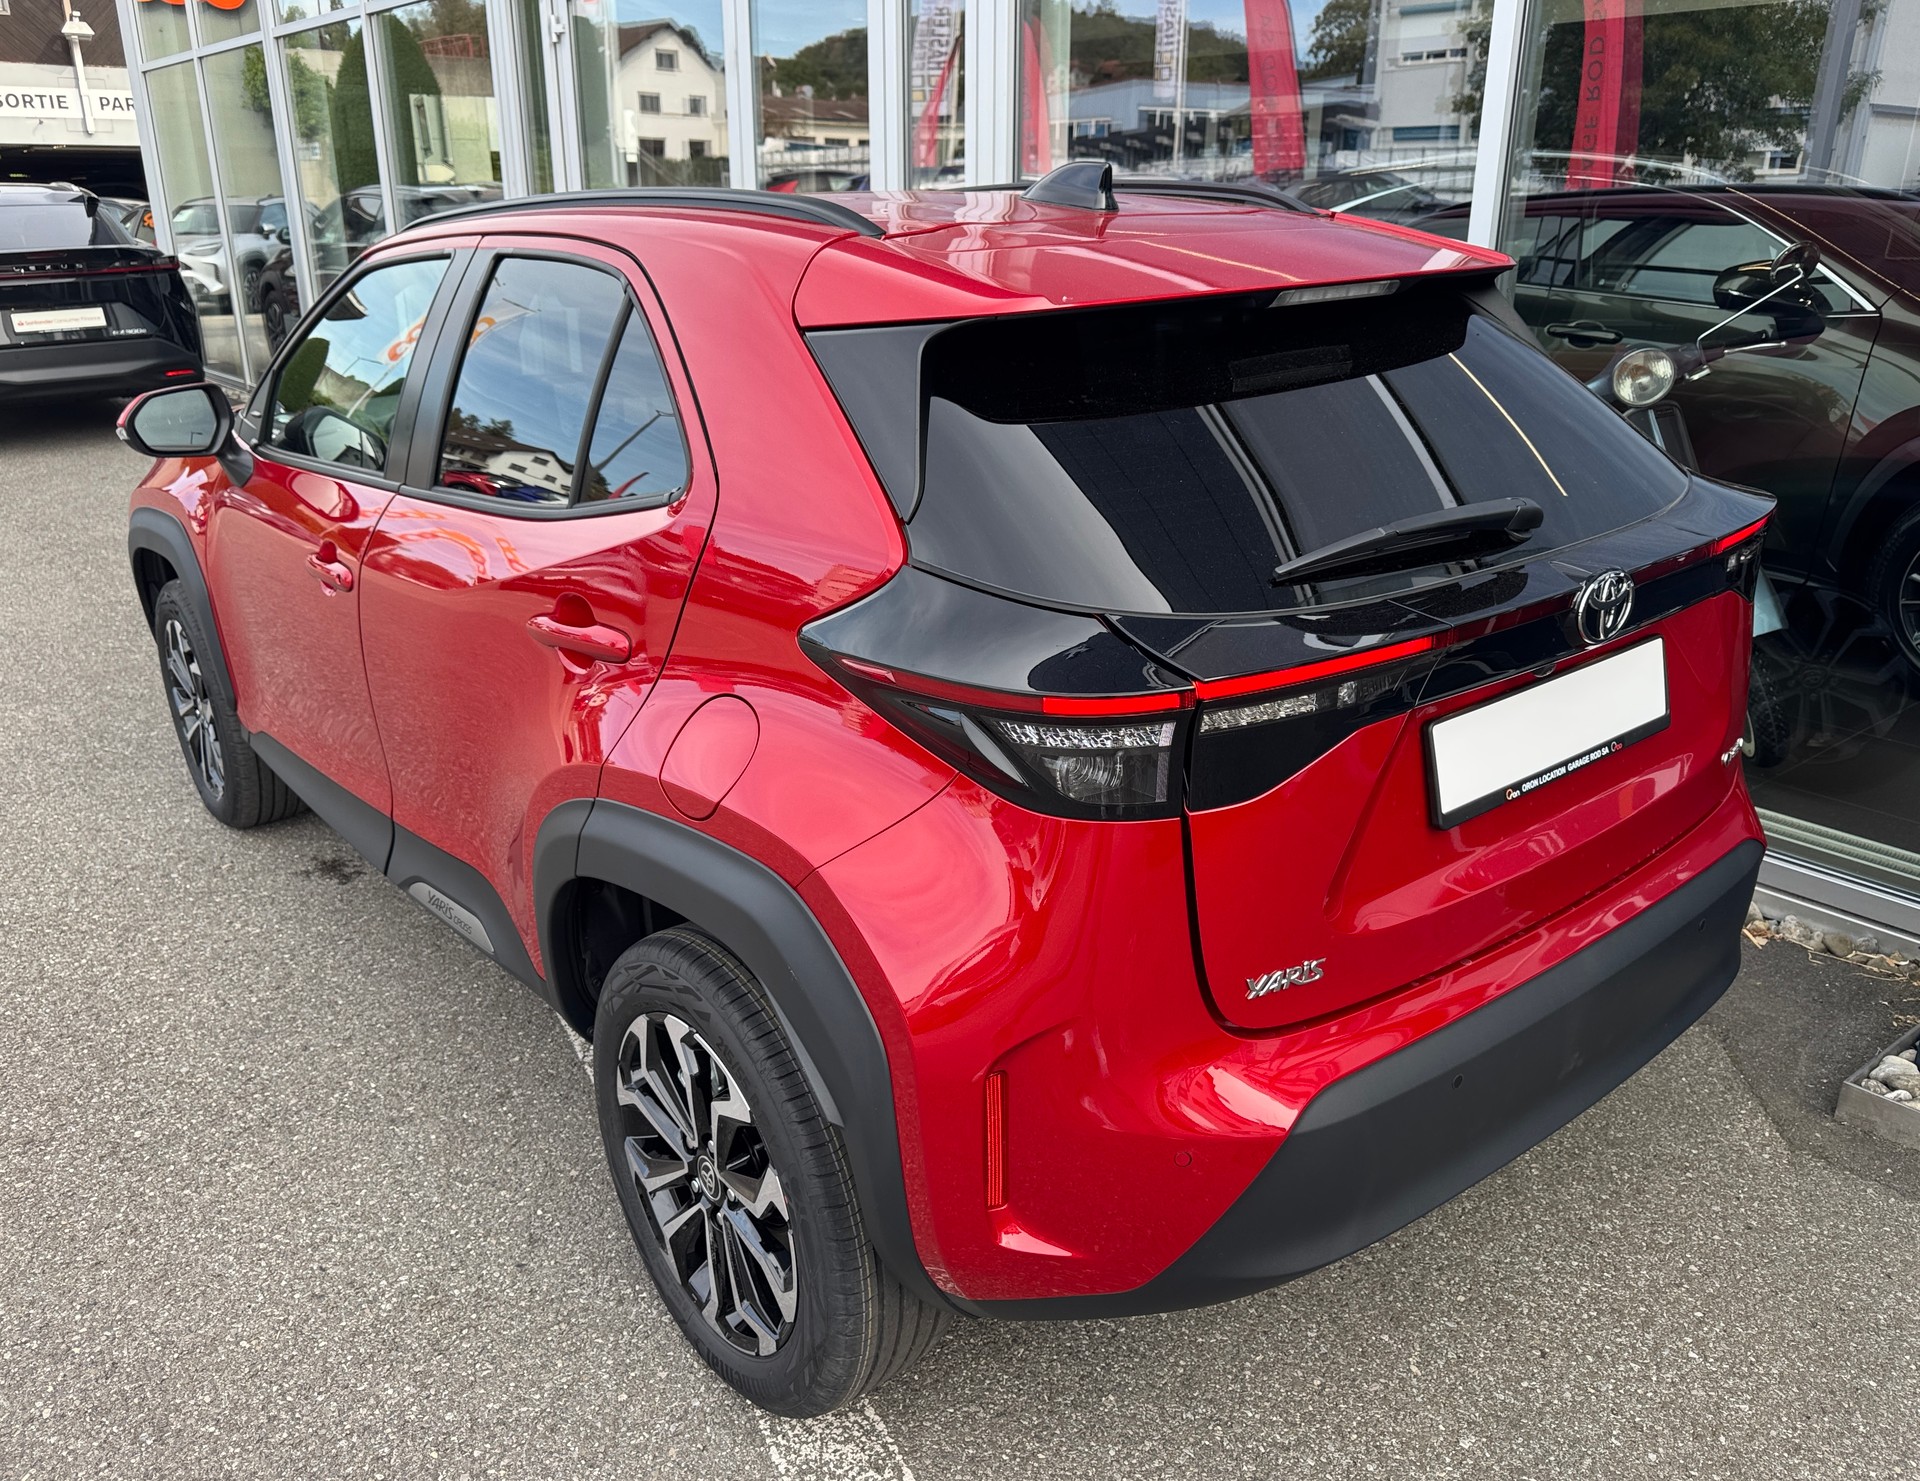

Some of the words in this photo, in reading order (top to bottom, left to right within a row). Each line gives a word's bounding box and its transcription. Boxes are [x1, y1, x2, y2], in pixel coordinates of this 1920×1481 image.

[0, 93, 69, 110] ORTIE
[1521, 778, 1539, 793] ORON
[1539, 765, 1567, 785] LOCATION
[1567, 754, 1590, 772] GARAGE
[1590, 749, 1601, 761] ROD
[1601, 745, 1610, 756] SA
